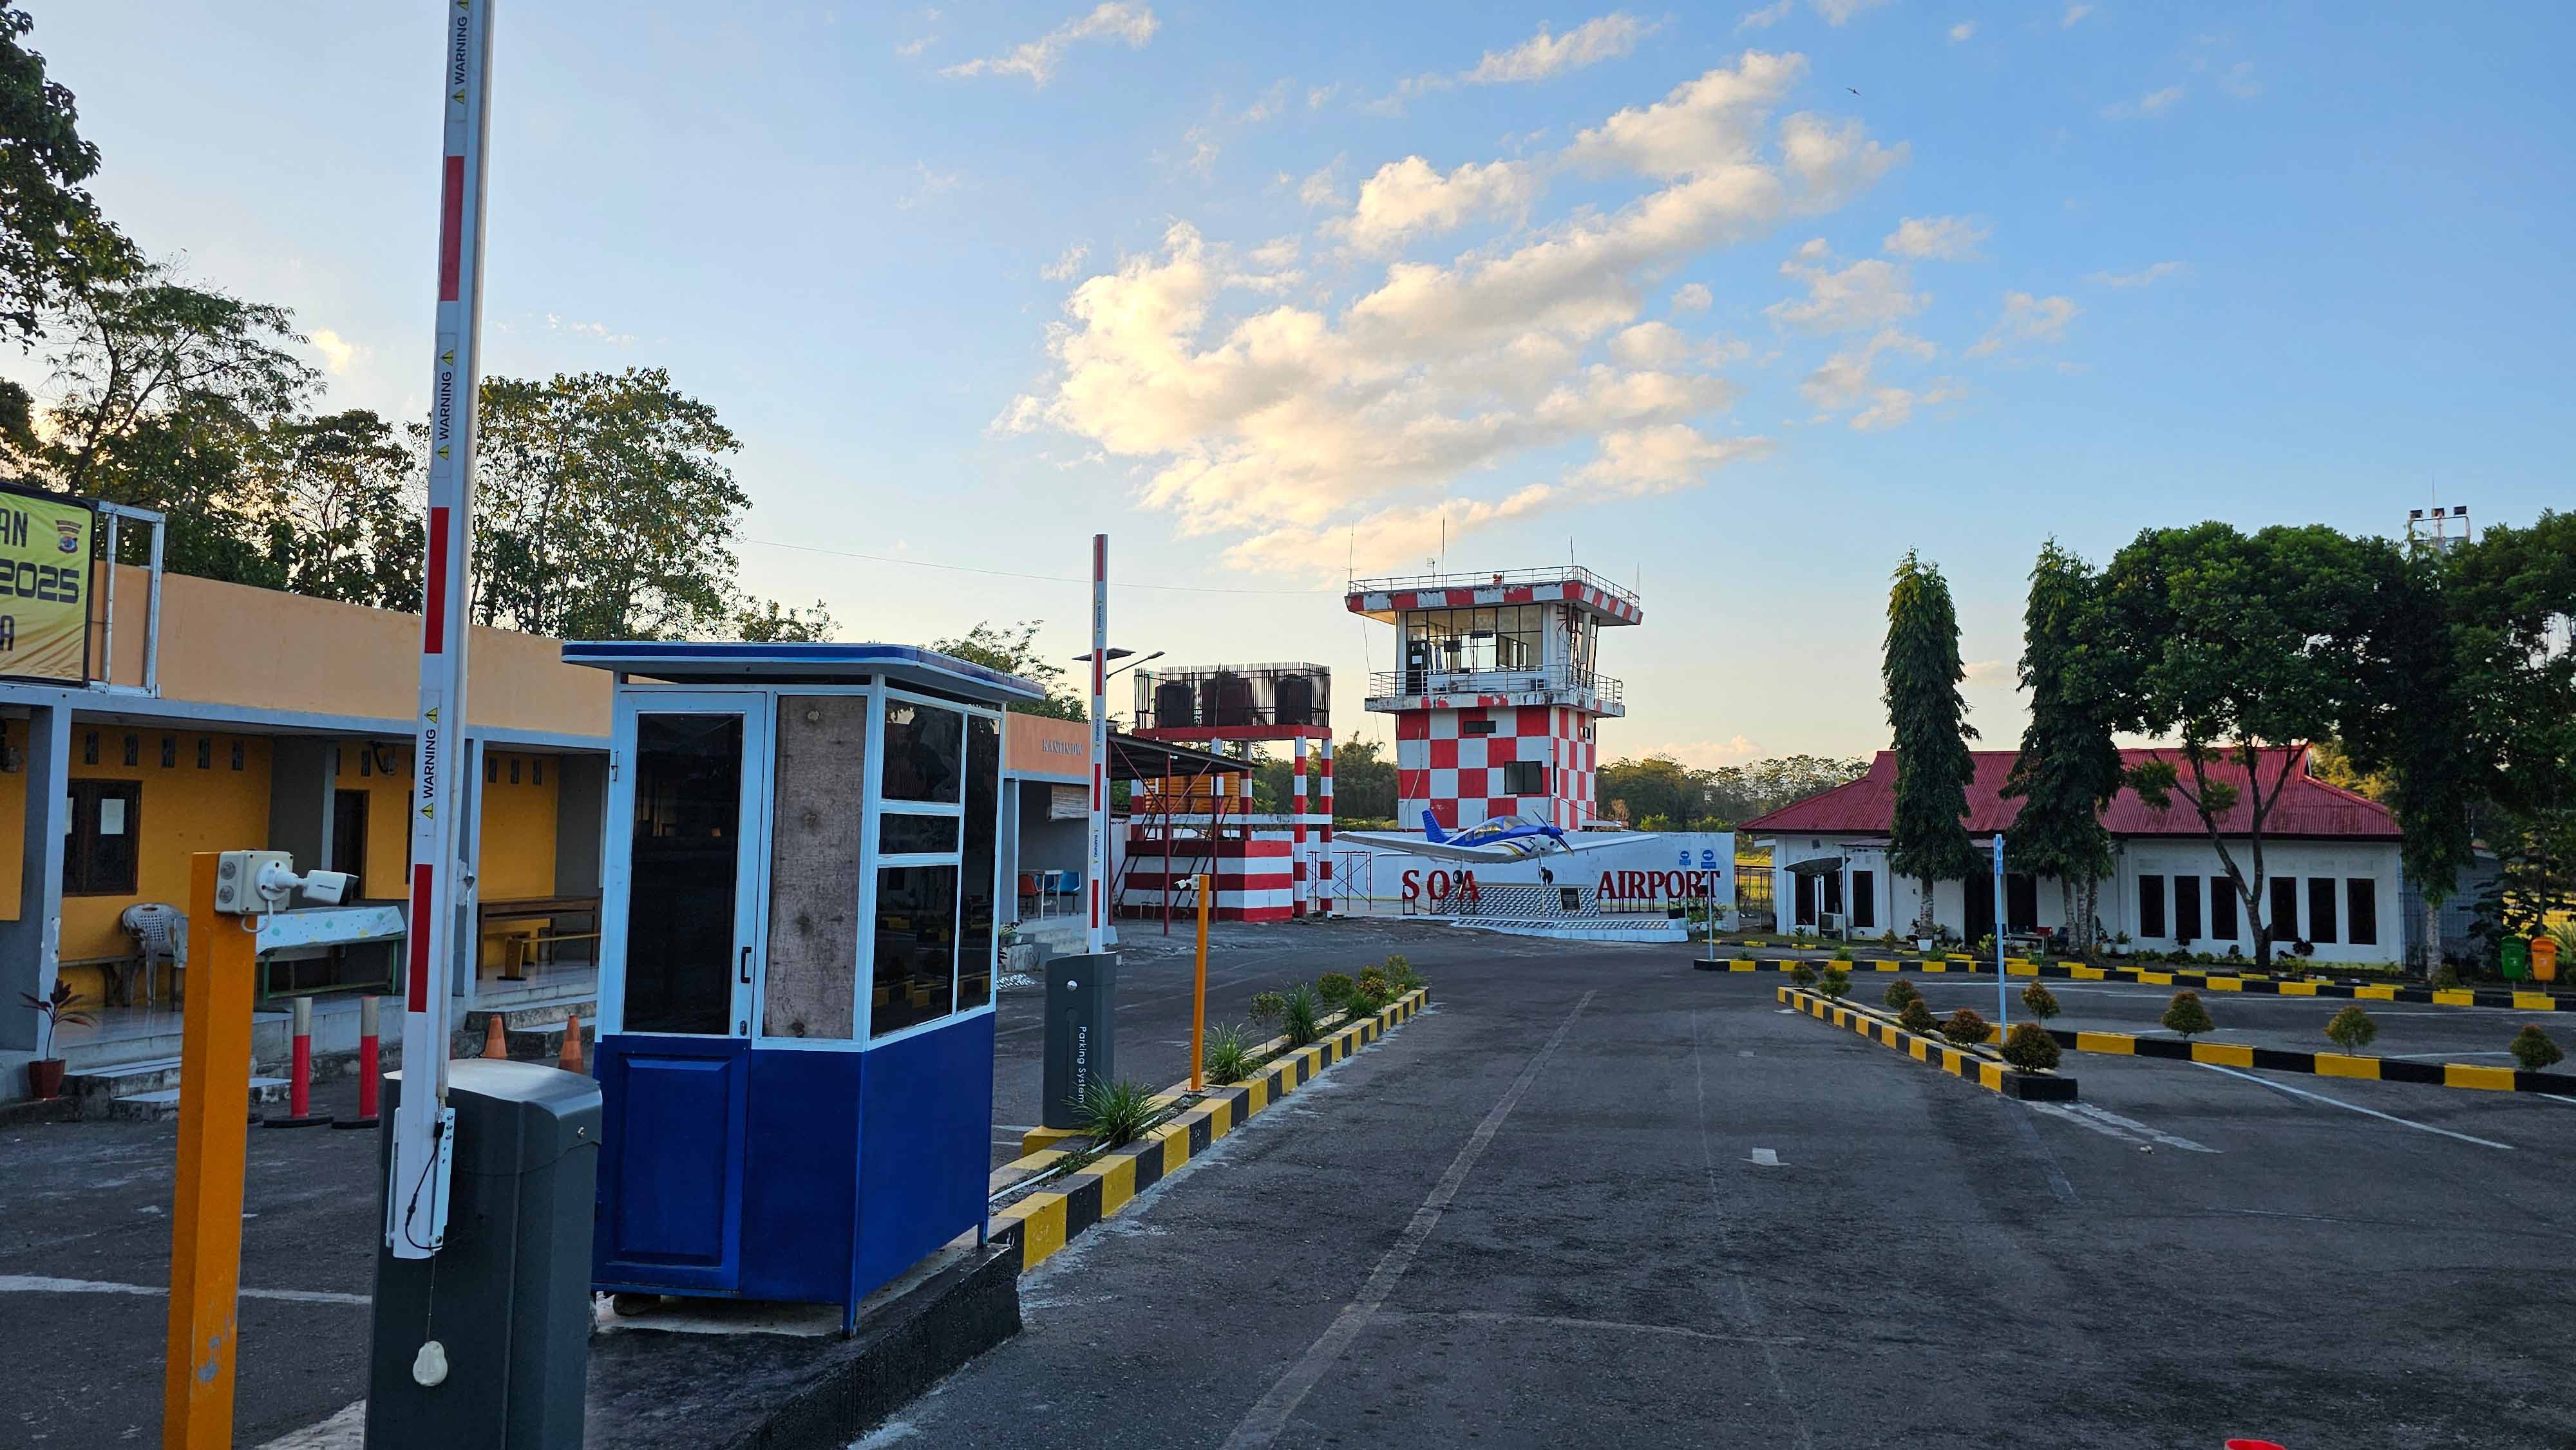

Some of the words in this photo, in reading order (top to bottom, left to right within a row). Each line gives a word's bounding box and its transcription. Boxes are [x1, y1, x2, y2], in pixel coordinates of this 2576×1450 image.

[455, 16, 468, 85] WARNING
[439, 372, 451, 440] WARNING
[0, 558, 79, 605] 2025
[423, 729, 436, 799] WARNING
[1596, 870, 1721, 899] AIRPORT
[1077, 1026, 1087, 1064] Parking
[1077, 1068, 1087, 1104] System
